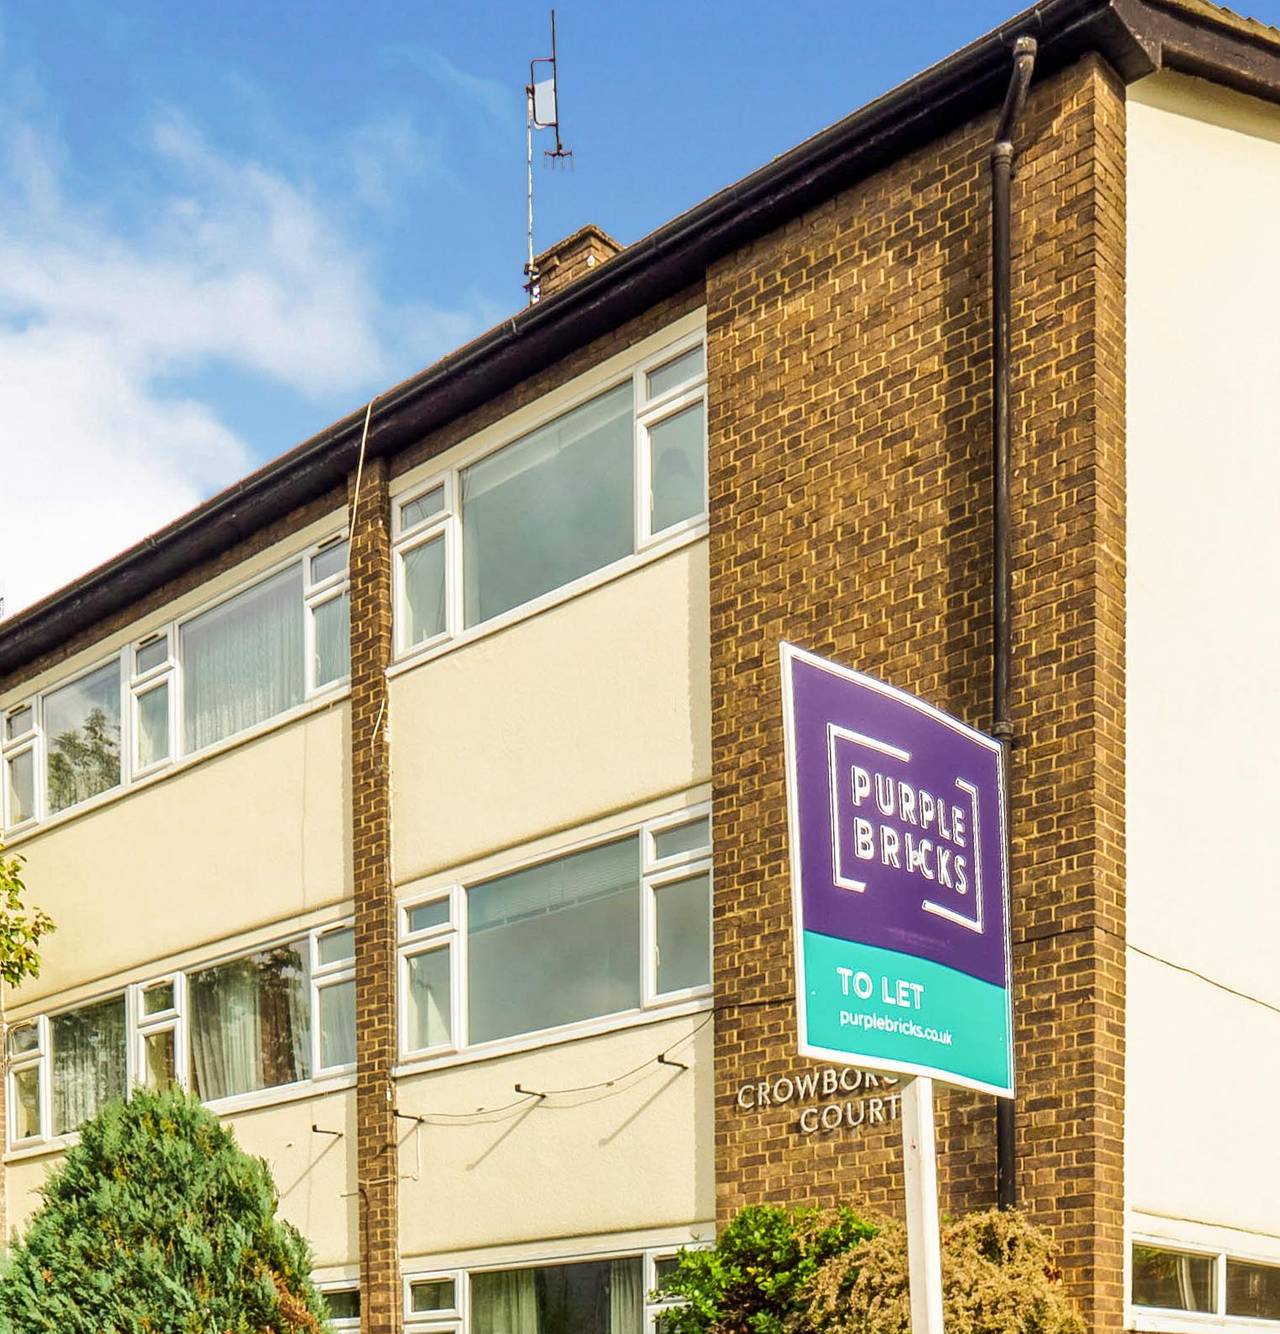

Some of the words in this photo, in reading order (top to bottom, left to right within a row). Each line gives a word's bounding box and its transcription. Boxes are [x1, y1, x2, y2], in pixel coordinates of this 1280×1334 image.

[851, 765, 967, 848] PURPLE
[853, 816, 968, 895] BRICKS
[836, 966, 873, 999] TO
[881, 975, 925, 1010] LET
[839, 1009, 953, 1046] purplebricks.co.uk
[800, 1094, 902, 1132] COURT
